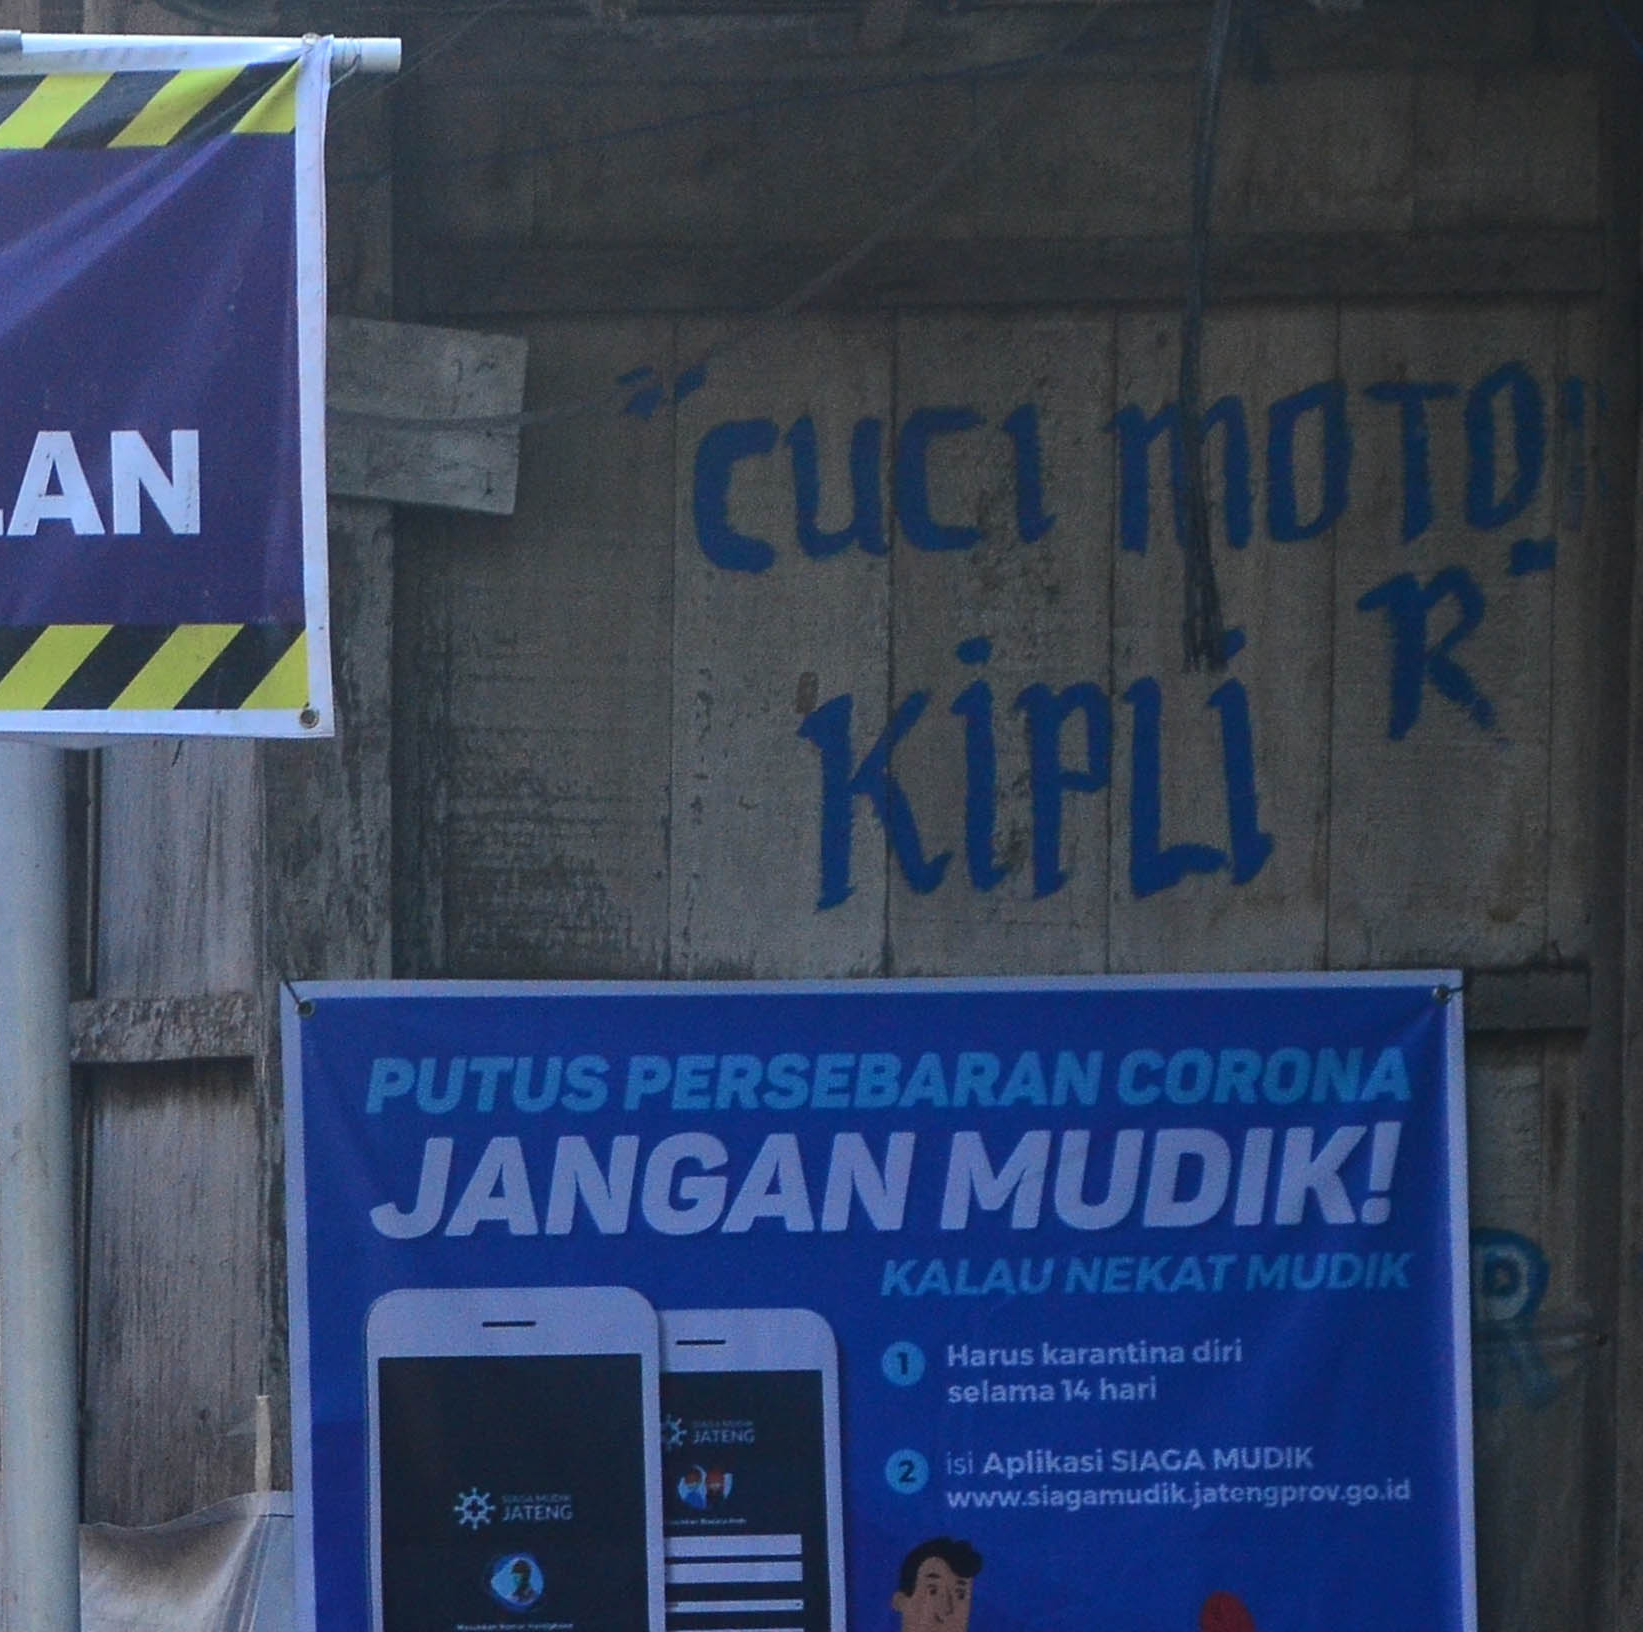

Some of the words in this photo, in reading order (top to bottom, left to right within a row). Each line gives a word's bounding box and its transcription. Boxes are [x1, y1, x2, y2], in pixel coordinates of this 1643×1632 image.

[365, 1056, 611, 1115] PUTUS
[623, 1051, 1103, 1111] PERSEBARAN
[1115, 1046, 1412, 1107] CORONA
[369, 1131, 916, 1240] JANGAN
[940, 1120, 1402, 1230] MUDIK!
[880, 1258, 1053, 1297] KALAU
[1064, 1254, 1238, 1295] NEKAT
[1246, 1251, 1414, 1292] MUDIK
[946, 1343, 1035, 1368] Harus
[1041, 1340, 1185, 1366] karantina
[1191, 1338, 1244, 1364] diri
[947, 1380, 1055, 1405] selama
[1061, 1379, 1091, 1403] 14
[1099, 1377, 1157, 1401] hari
[693, 1428, 756, 1444] JATENG
[945, 1451, 974, 1476] isi
[982, 1448, 1104, 1480] Aplikasi
[1110, 1447, 1206, 1473] SIAGA
[1213, 1445, 1315, 1471] MUDIK
[946, 1478, 1412, 1511] www.siagamudik.jatengprov.go.id
[502, 1504, 573, 1522] JATENG
